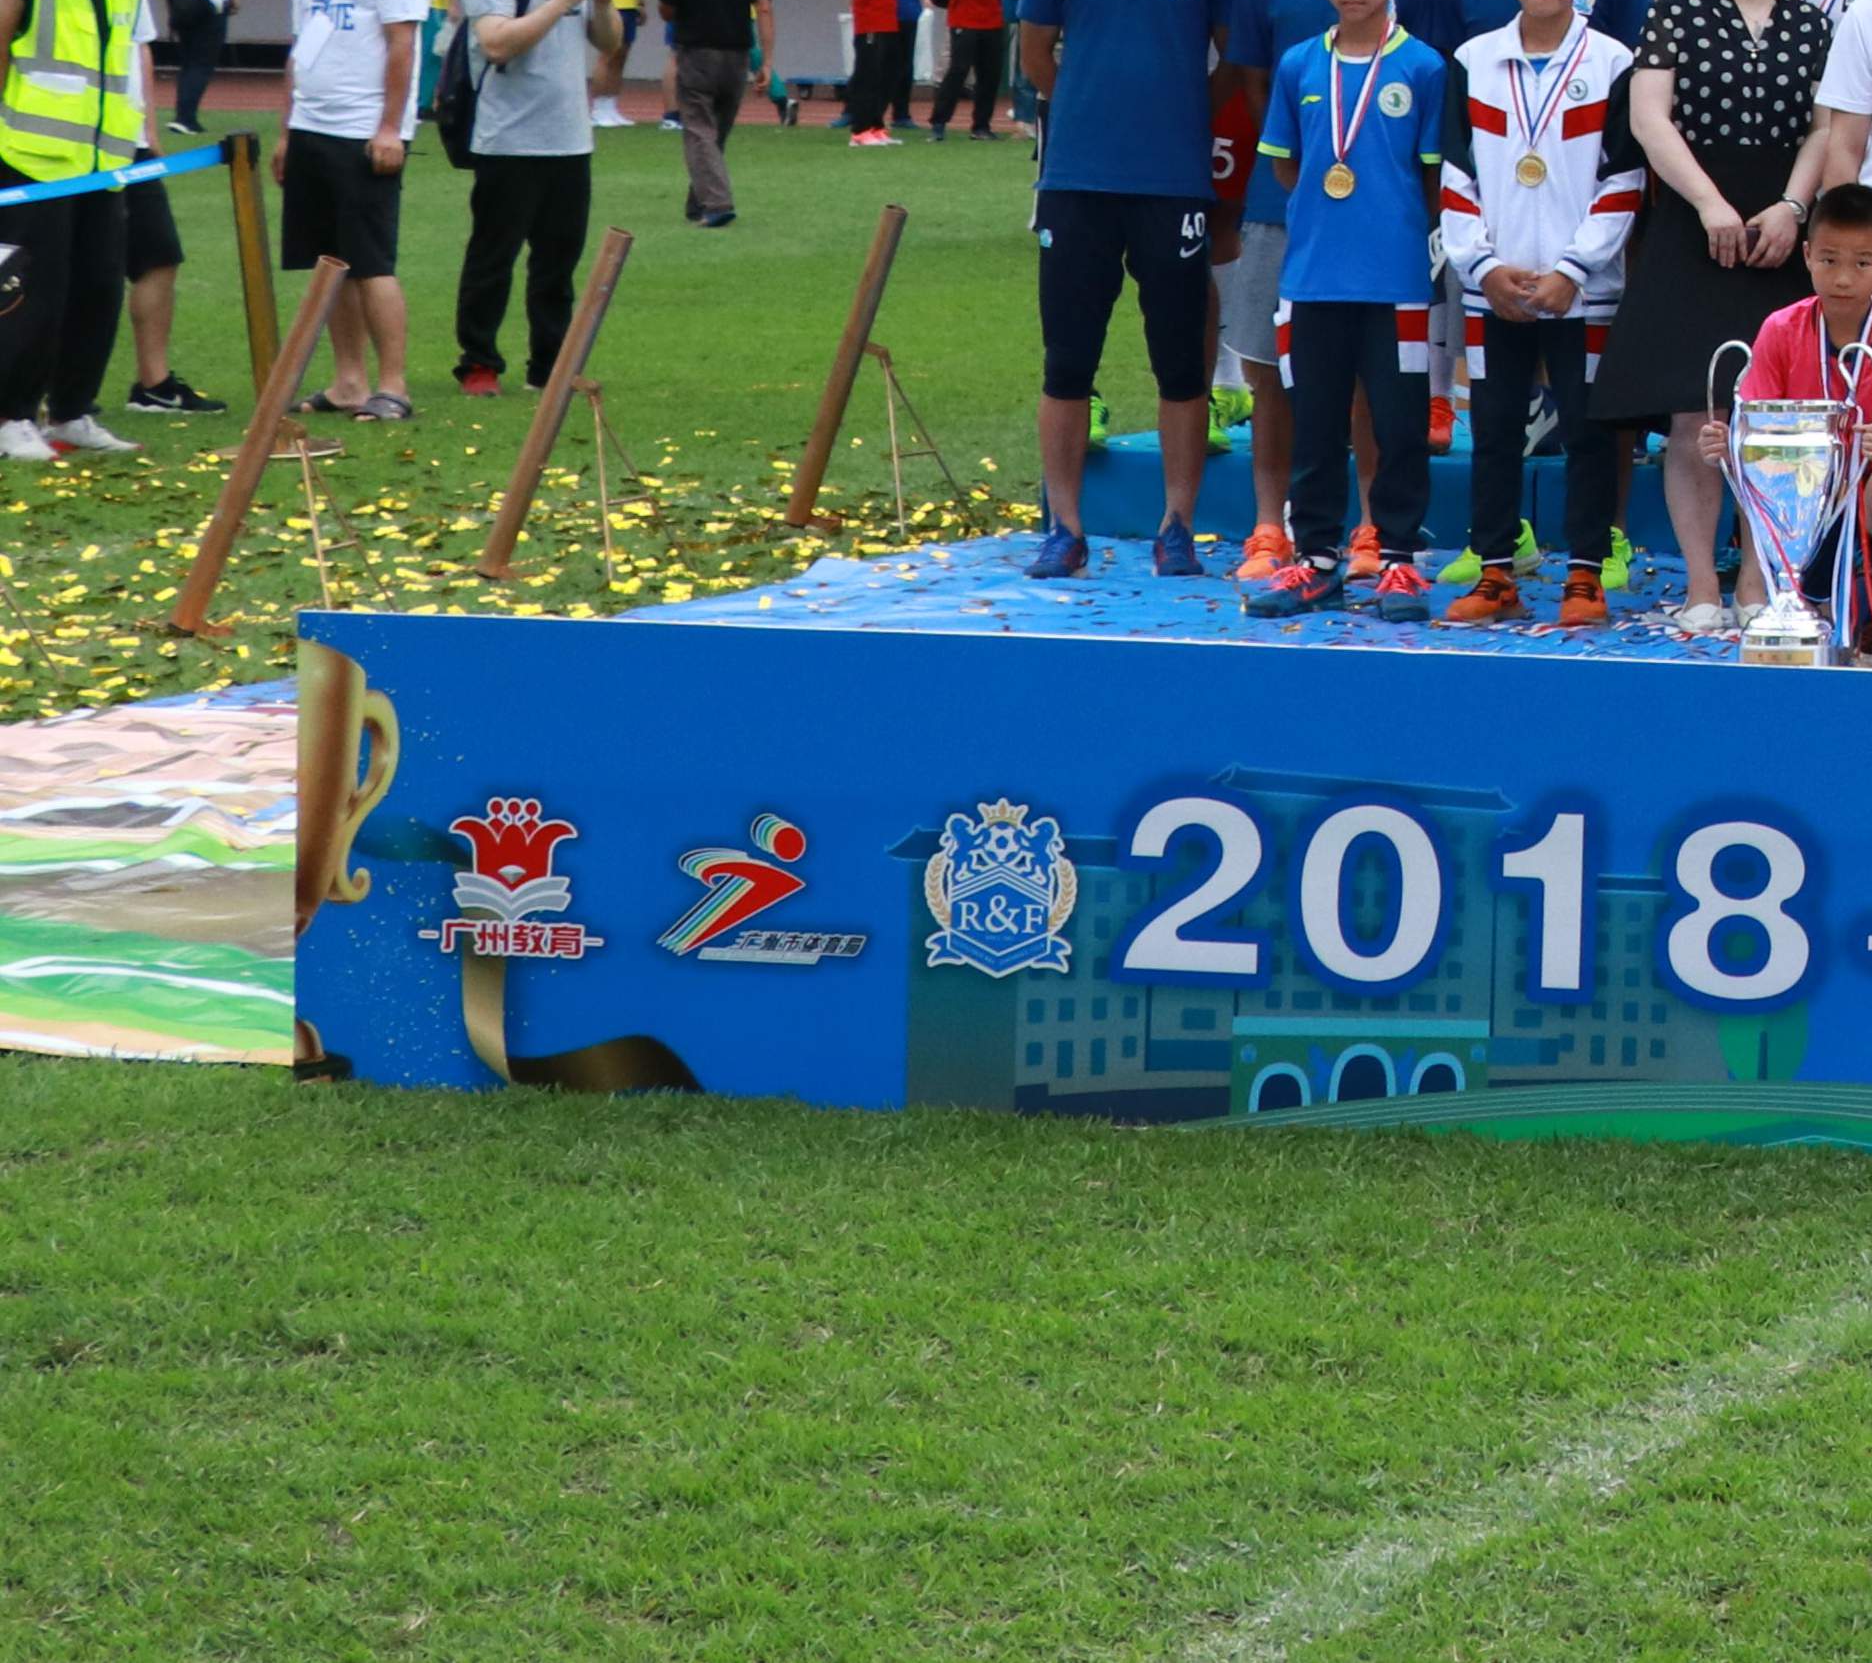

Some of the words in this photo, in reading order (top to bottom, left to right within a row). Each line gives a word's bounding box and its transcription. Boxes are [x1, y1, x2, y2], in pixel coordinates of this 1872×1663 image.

[1211, 137, 1236, 180] 5
[1181, 211, 1206, 240] 40
[958, 894, 1045, 935] R&F
[442, 922, 585, 959] 广州教育
[740, 930, 867, 956] 广州市体育局
